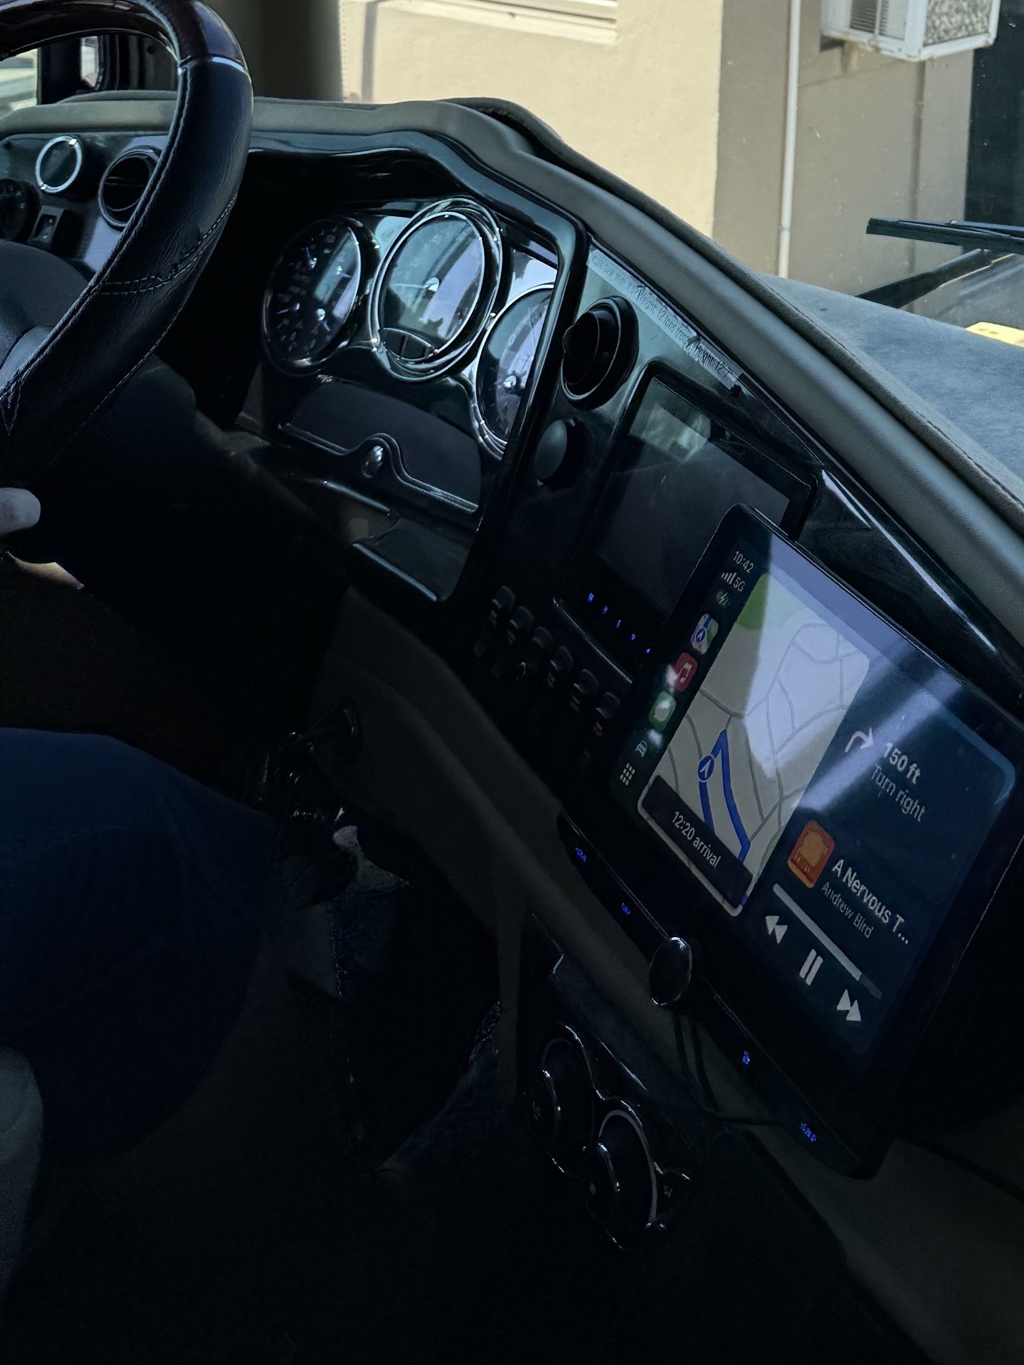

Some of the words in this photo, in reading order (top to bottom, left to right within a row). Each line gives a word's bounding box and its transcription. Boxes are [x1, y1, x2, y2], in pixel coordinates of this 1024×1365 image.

[733, 550, 755, 574] 10:42
[733, 577, 746, 592] 5G
[883, 742, 908, 772] 150
[906, 762, 921, 785] ft
[871, 763, 896, 797] Turn
[895, 789, 926, 822] right
[672, 811, 695, 840] 12:20
[692, 836, 722, 868] arrival
[821, 881, 854, 919] Andrew
[853, 912, 875, 939] Bird
[832, 858, 844, 877] A
[842, 866, 892, 924] Nervous
[892, 913, 909, 945] T...
